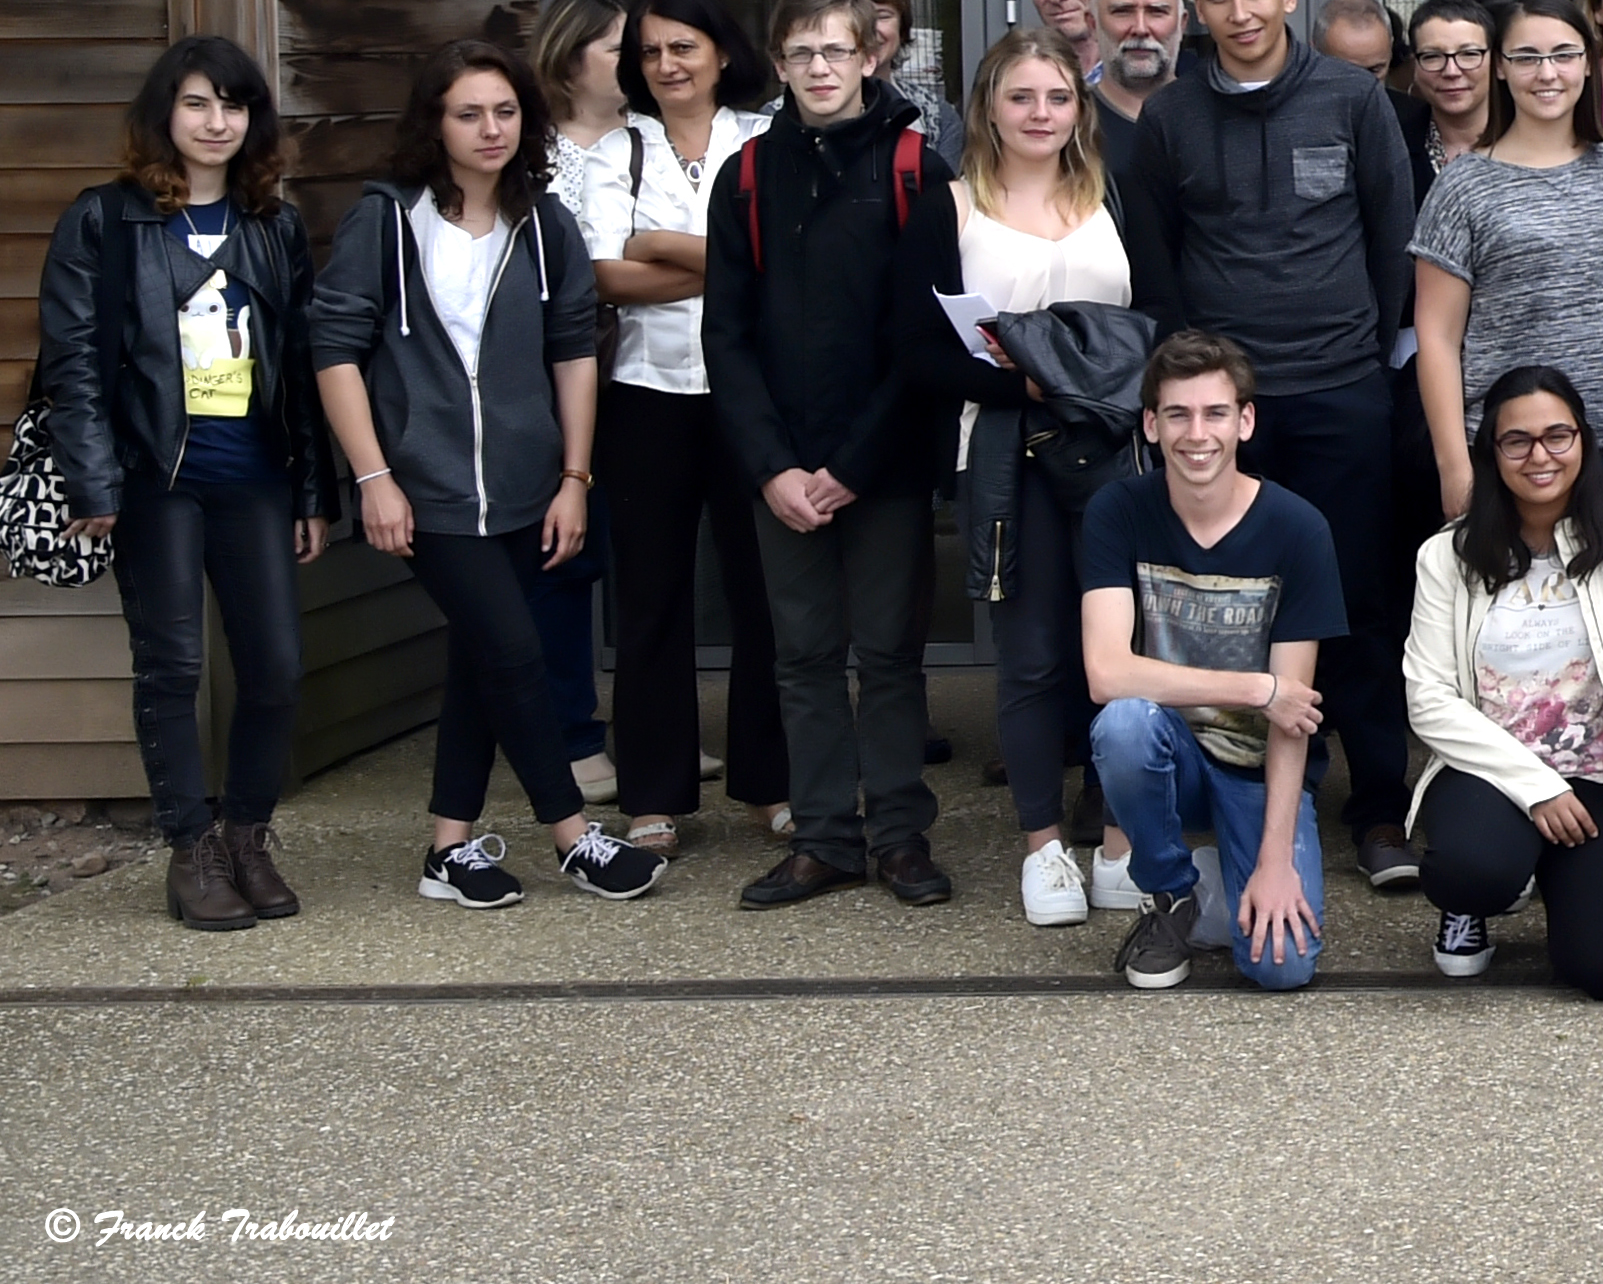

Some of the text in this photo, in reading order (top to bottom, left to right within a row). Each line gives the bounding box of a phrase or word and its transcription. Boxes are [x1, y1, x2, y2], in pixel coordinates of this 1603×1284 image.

[187, 371, 243, 385] DINGER'S
[1522, 618, 1559, 628] ALWAYS
[1505, 626, 1575, 640] LOOK ON THE
[1557, 640, 1571, 649] OF
